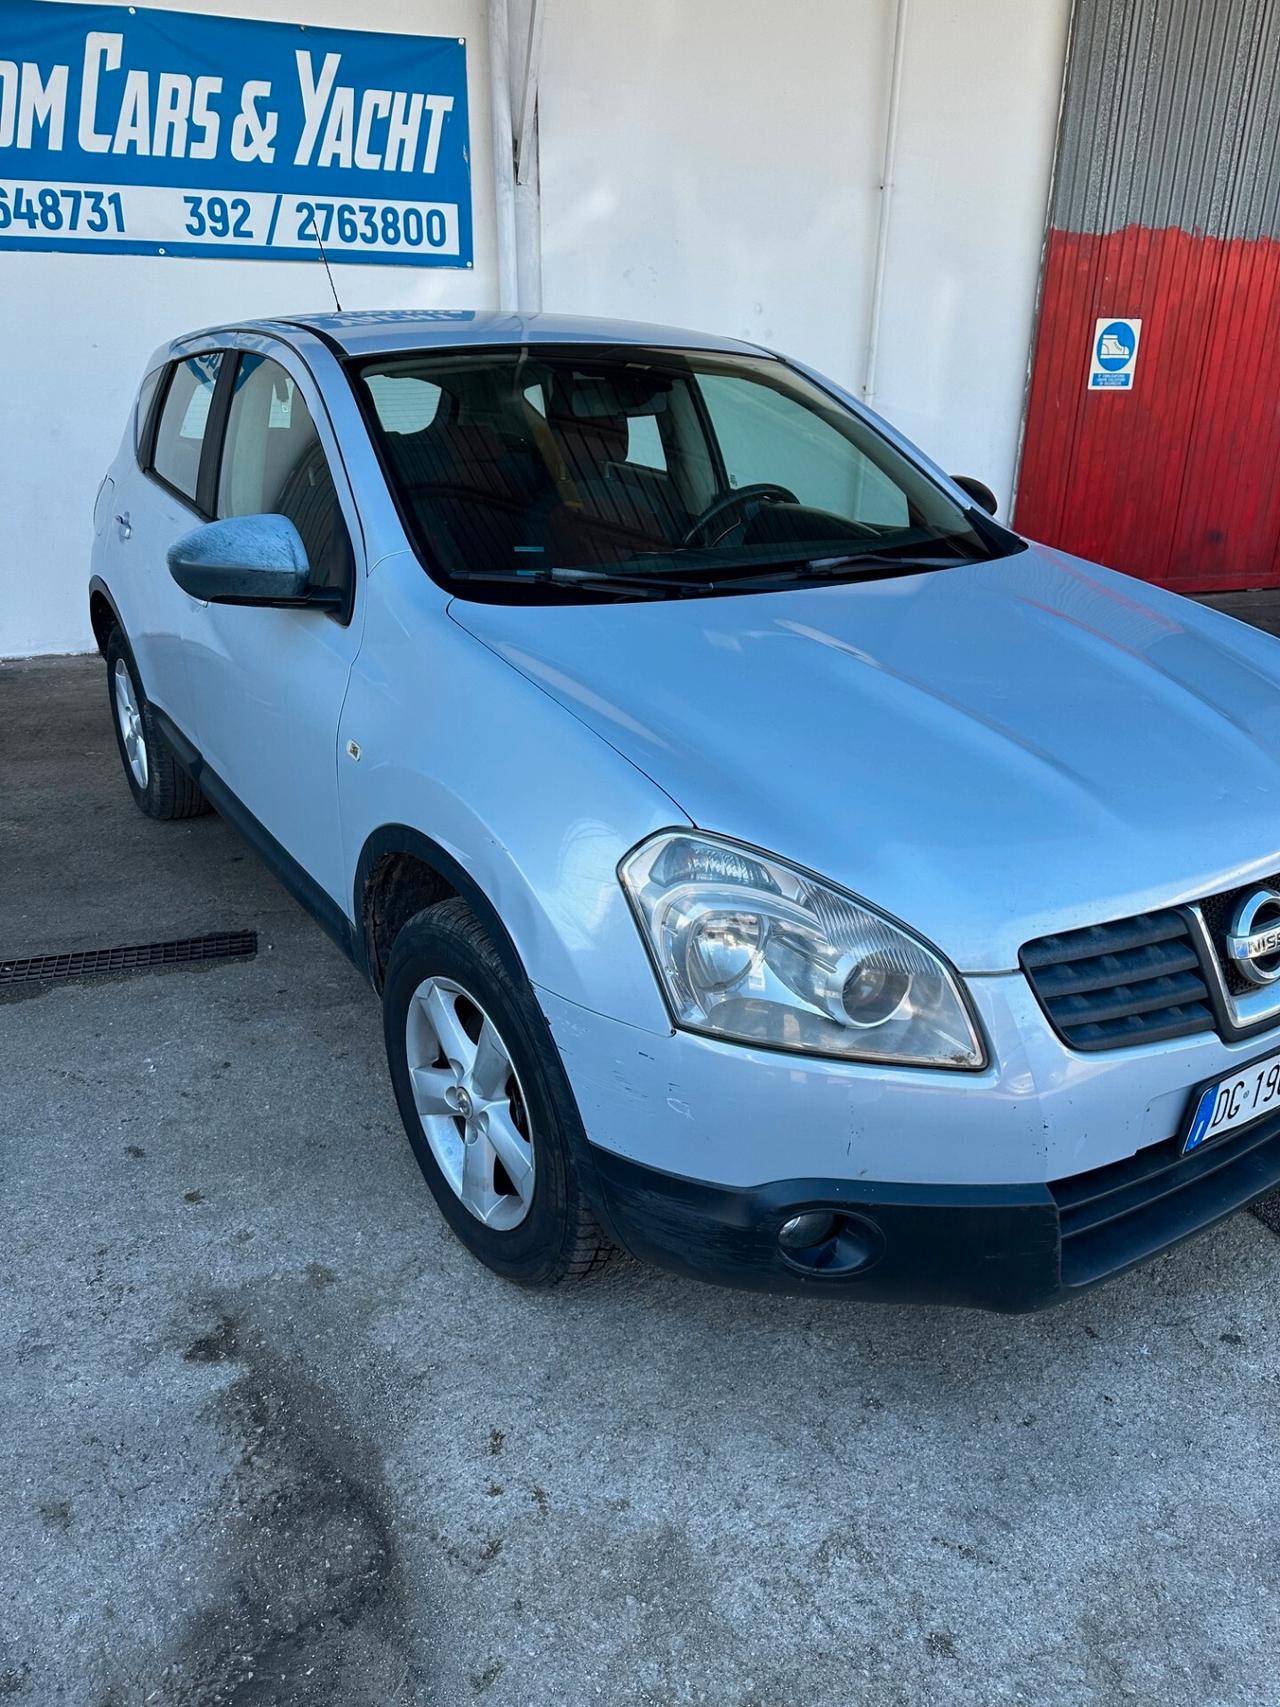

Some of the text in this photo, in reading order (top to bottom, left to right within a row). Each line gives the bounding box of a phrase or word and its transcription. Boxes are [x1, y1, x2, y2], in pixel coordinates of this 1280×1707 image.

[78, 32, 223, 160] CARS
[230, 80, 278, 164] &
[294, 50, 454, 174] YACHT
[183, 196, 254, 238] 392
[266, 194, 283, 246] /
[296, 201, 447, 248] 2763800
[1252, 1063, 1280, 1108] 19
